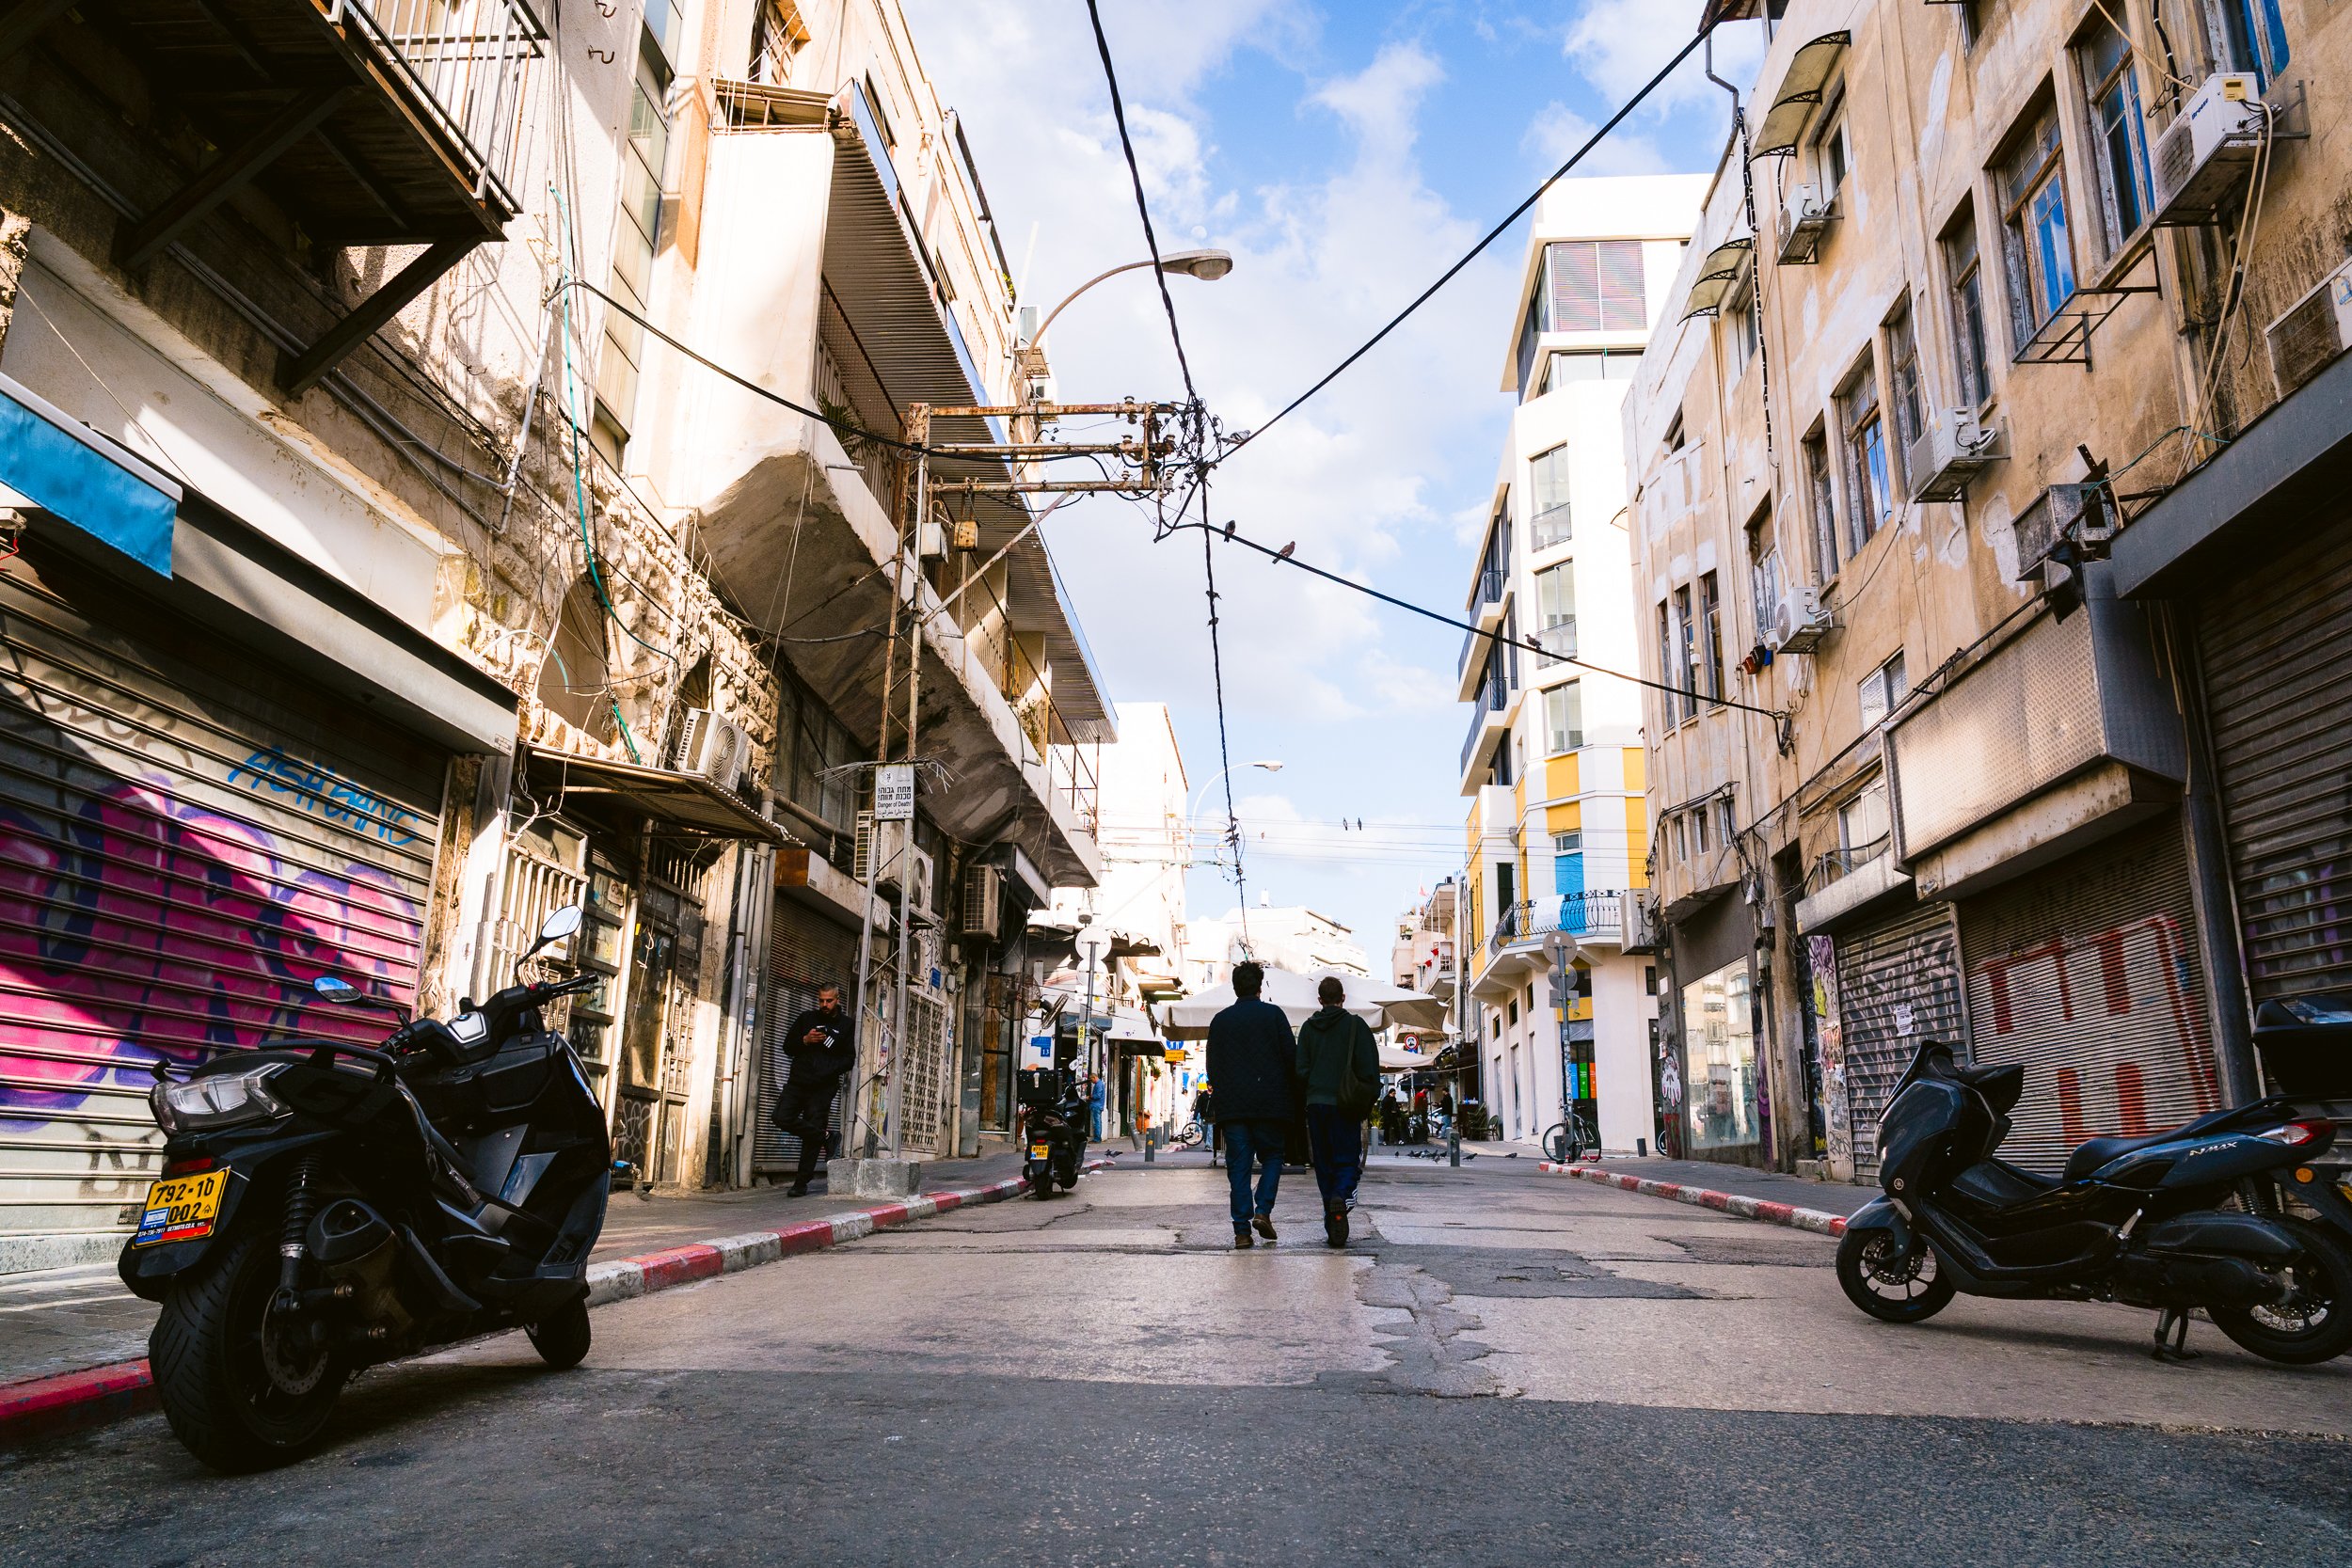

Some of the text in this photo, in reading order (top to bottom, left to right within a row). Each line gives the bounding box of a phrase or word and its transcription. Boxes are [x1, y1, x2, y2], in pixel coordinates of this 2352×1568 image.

[2189, 1141, 2238, 1157] NMAX
[153, 1178, 215, 1206] 792-10
[167, 1202, 202, 1224] 002
